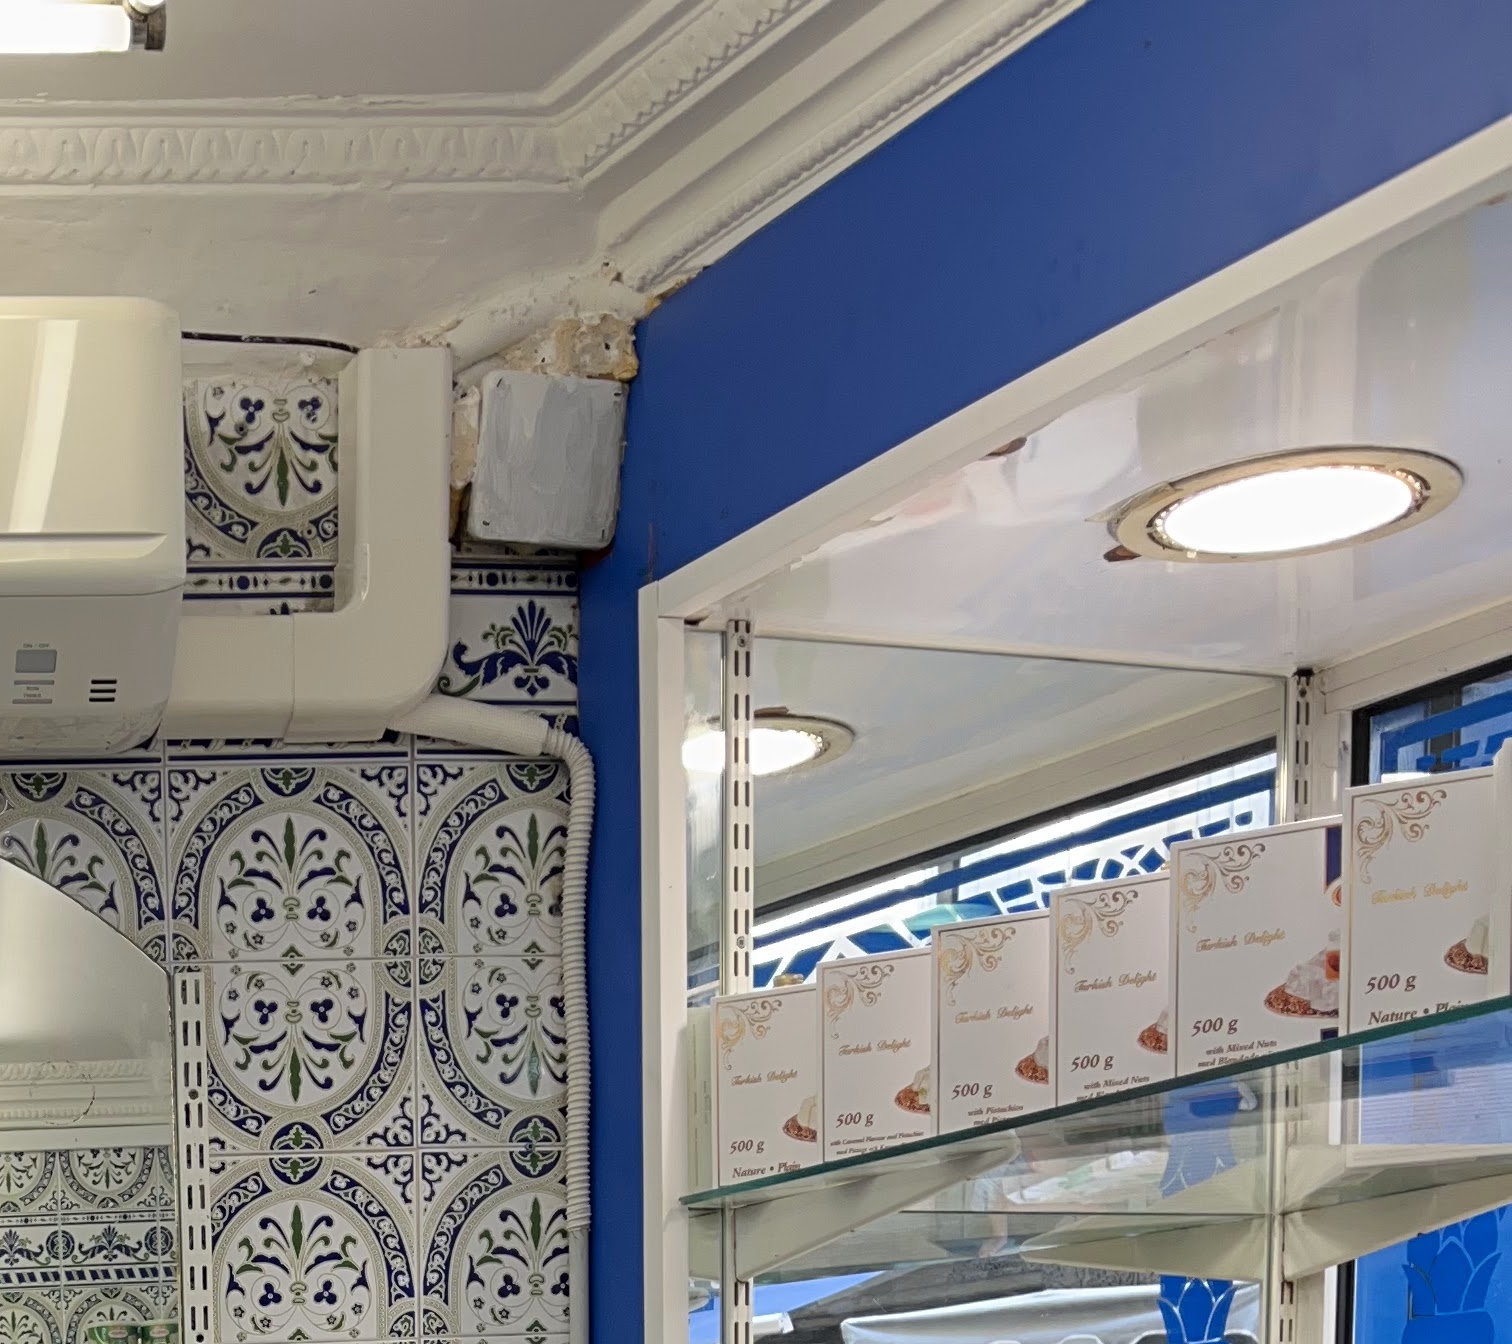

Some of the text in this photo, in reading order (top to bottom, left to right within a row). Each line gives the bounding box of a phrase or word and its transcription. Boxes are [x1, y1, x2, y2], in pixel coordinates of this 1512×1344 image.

[1196, 928, 1286, 952] Turkish Delight
[1074, 970, 1157, 992] Turkish Delight
[1365, 974, 1417, 995] 500 g
[955, 1004, 1033, 1024] Turkish Delight
[1368, 1011, 1418, 1026] Nature
[1191, 1017, 1239, 1038] 500 g
[838, 1037, 912, 1056] Turkish Delight
[1226, 1041, 1254, 1053] Mixed
[1070, 1054, 1114, 1072] 500 g
[731, 1069, 798, 1086] Turkish Delight
[951, 1083, 993, 1100] 500 g
[835, 1112, 874, 1128] 500 g
[729, 1140, 765, 1154] 500 g
[732, 1167, 766, 1178] Nature
